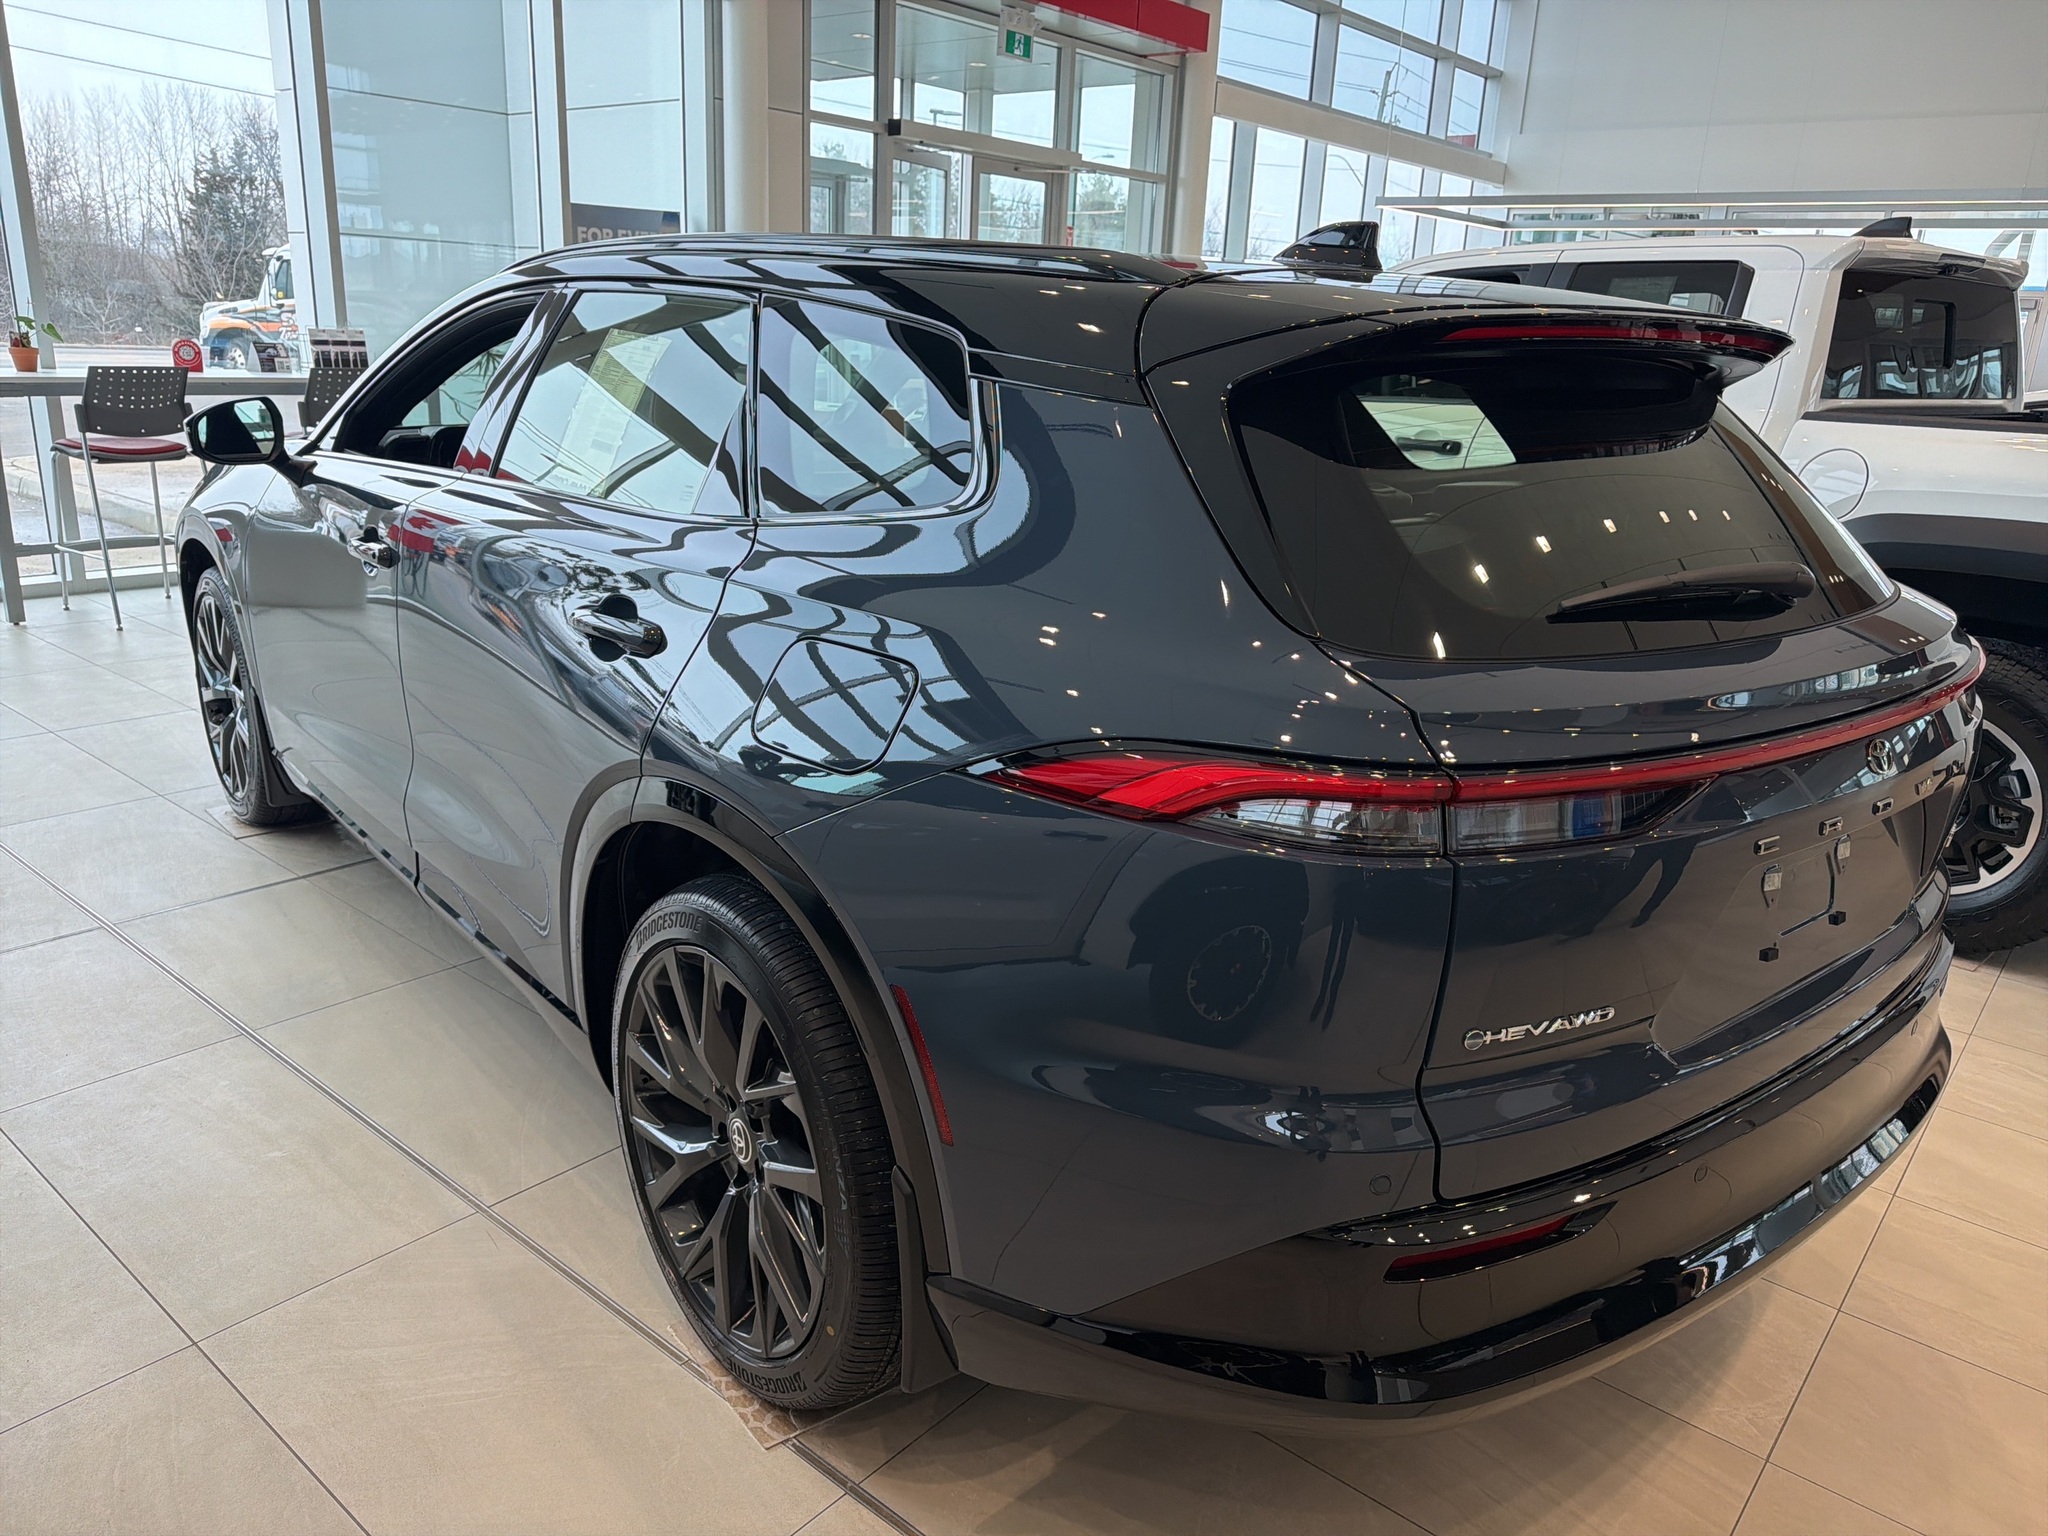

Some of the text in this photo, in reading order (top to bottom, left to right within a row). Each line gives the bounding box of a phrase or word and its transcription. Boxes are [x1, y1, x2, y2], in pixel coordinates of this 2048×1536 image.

[577, 226, 613, 243] FOR
[635, 911, 703, 953] BRIDGESTONE
[726, 1356, 808, 1394] BRIDGESTONE
